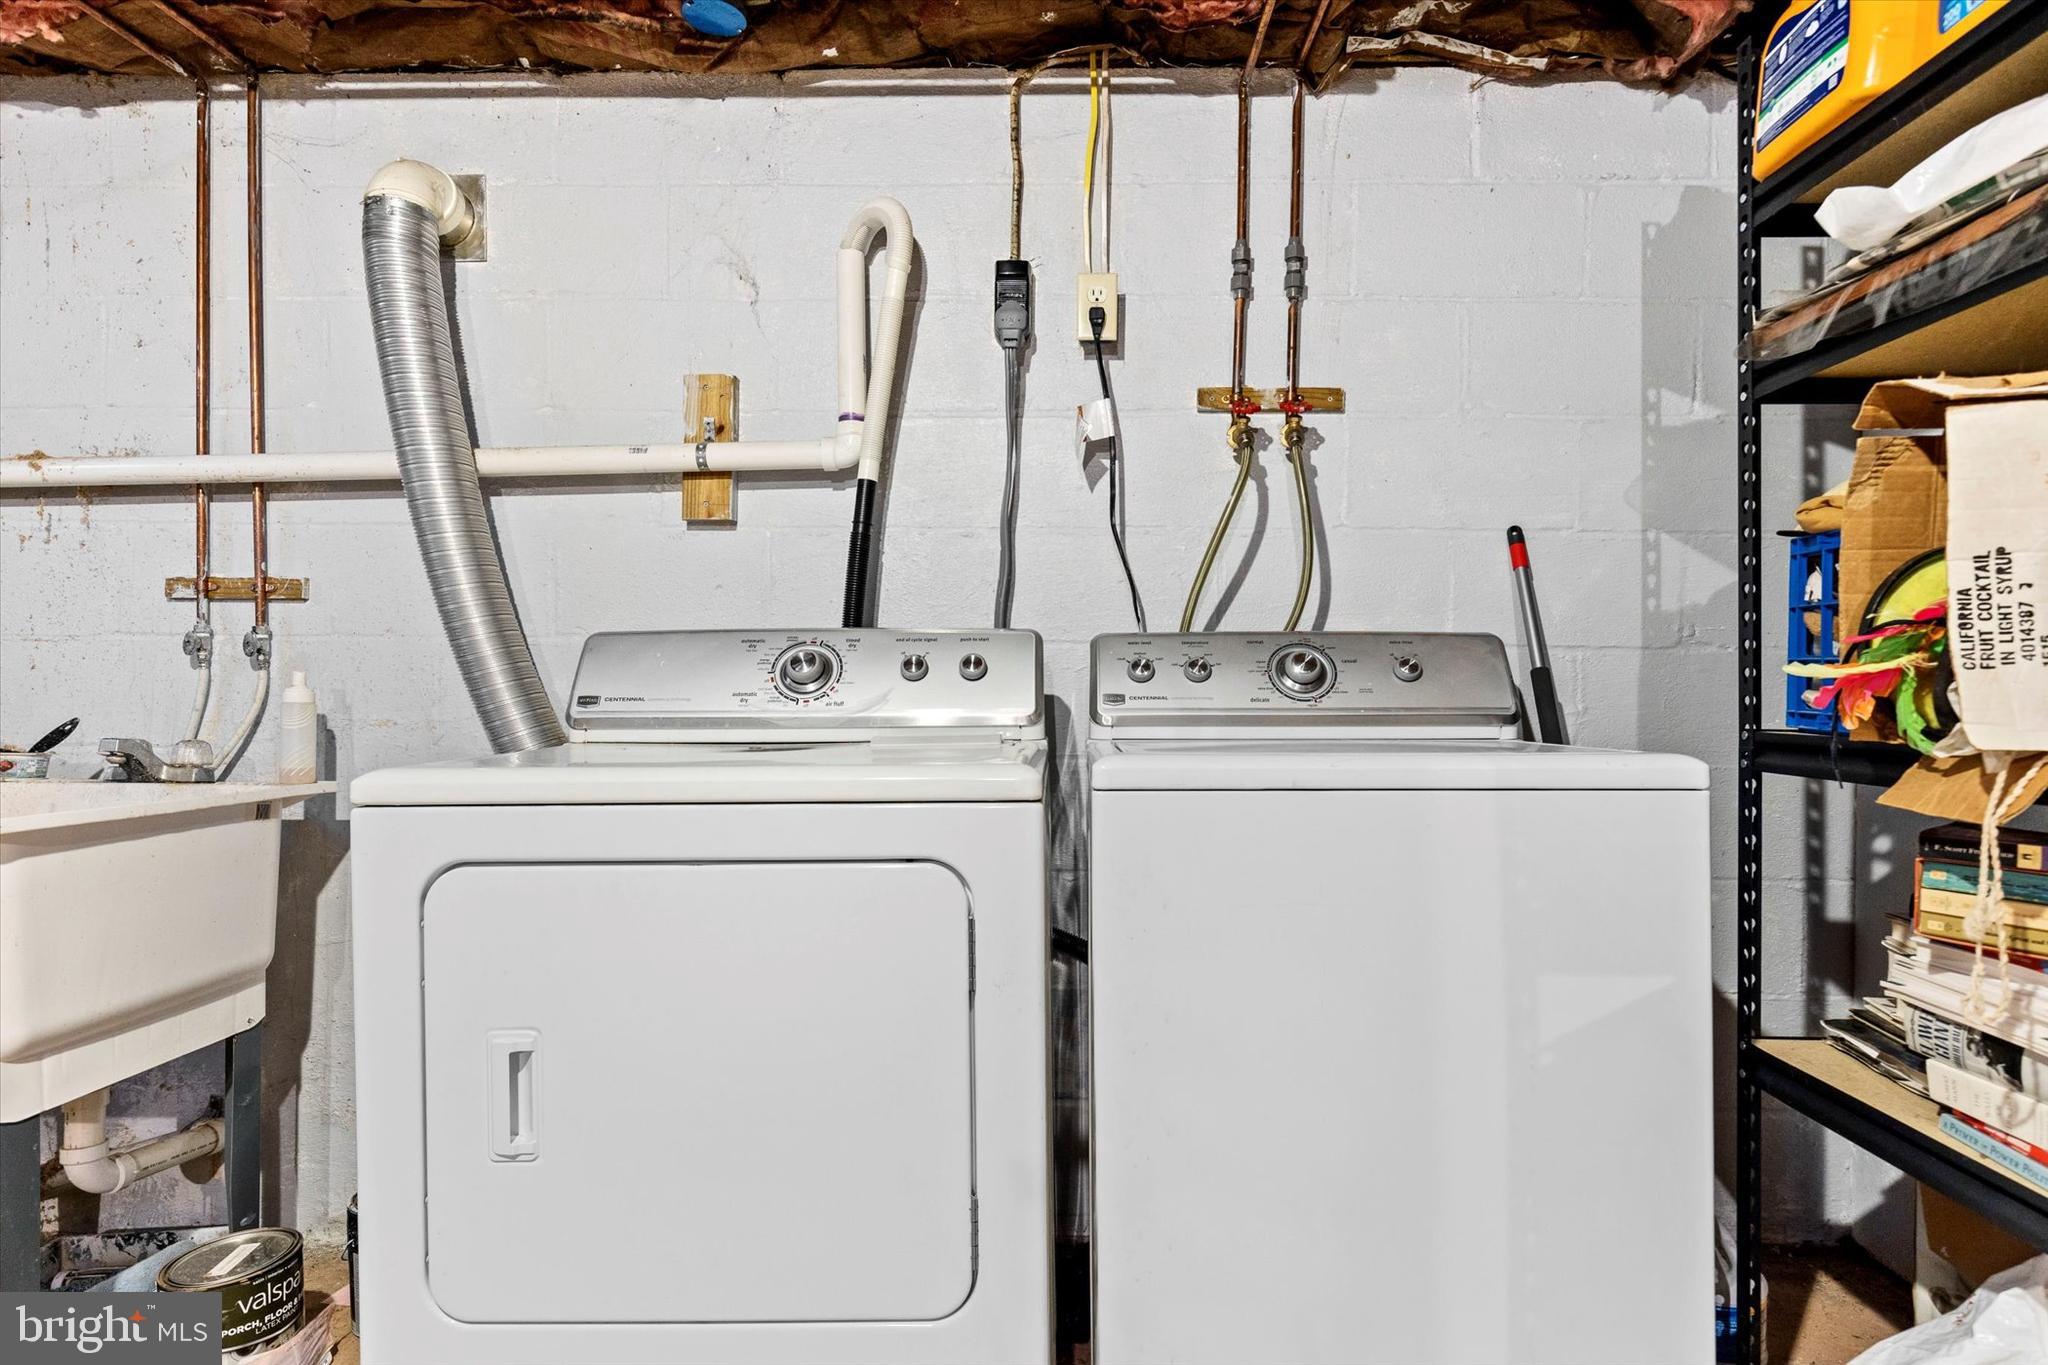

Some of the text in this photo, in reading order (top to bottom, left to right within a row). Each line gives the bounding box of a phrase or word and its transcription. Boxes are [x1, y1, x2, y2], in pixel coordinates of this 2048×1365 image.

[1956, 587, 1976, 670] CALIFORNIA
[1972, 550, 1996, 670] FRUIT COCKTAIL
[1994, 546, 2016, 666] IN LIGHT SYRUP
[2018, 601, 2036, 661] 4014387
[1990, 1145, 2020, 1168] POWER
[222, 1319, 263, 1338] PORCH,
[264, 1301, 293, 1323] FLOOR
[255, 1317, 281, 1335] LATEX
